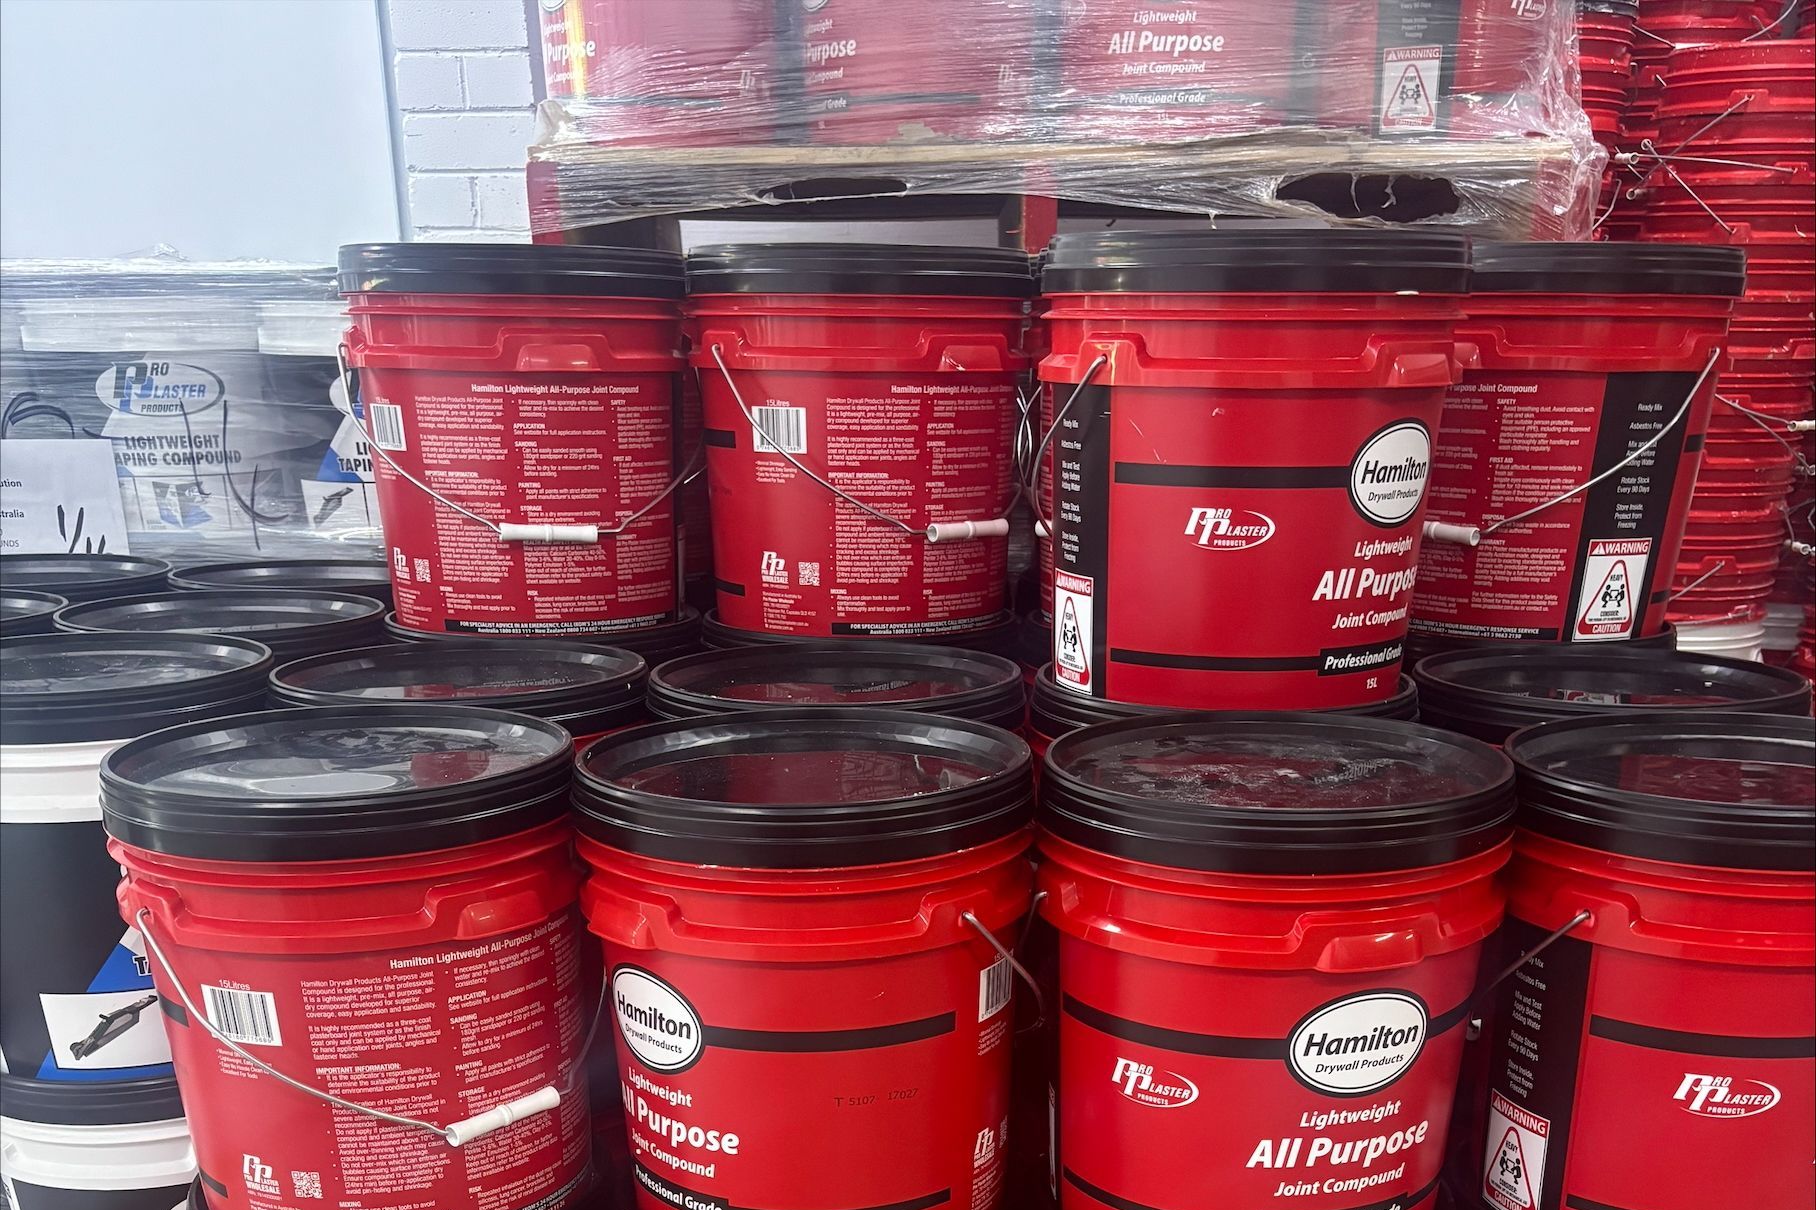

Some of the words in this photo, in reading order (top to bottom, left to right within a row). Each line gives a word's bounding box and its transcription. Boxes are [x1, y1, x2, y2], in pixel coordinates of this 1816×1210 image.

[1133, 10, 1197, 25] Lightweight
[1108, 31, 1135, 54] All
[1138, 31, 1224, 57] Purpose
[1396, 49, 1440, 59] WARNING
[1149, 61, 1205, 75] Compound
[1120, 92, 1177, 104] Professional
[1177, 92, 1206, 102] Grade
[471, 384, 503, 392] Hamilton
[505, 385, 548, 395] Lightweight
[550, 385, 590, 395] All-Purpose
[609, 386, 639, 395] Compound
[891, 385, 922, 393] Hamilton
[923, 386, 960, 395] Lightweight
[1478, 384, 1496, 392] Joint
[1497, 384, 1538, 394] Compound
[125, 435, 219, 450] LIGHTWEIGHT
[114, 452, 157, 466] APING
[163, 451, 242, 466] COMPOUND
[1360, 457, 1427, 485] Hamilton
[1367, 490, 1396, 502] Drywall
[1396, 487, 1418, 500] Products
[1184, 507, 1232, 535] PRO
[1198, 518, 1268, 544] PLASTER
[1354, 537, 1413, 560] Lightweight
[1605, 542, 1648, 554] WARNING
[1312, 568, 1356, 601] All
[1332, 613, 1364, 630] Joint
[1592, 624, 1621, 633] CAUTION
[1325, 648, 1385, 670] Professional
[1367, 677, 1377, 690] 15L
[390, 957, 434, 969] Hamilton
[436, 945, 489, 964] Lightweight
[491, 933, 532, 953] All-Purpose
[533, 926, 548, 940] Joint
[219, 979, 250, 990] 15Litres
[301, 980, 328, 988] Hamilton
[329, 979, 352, 987] Drywall
[354, 977, 381, 985] Products
[302, 988, 335, 996] Compound
[447, 990, 487, 1004] APPLICATION
[617, 990, 692, 1041] Hamilton
[625, 1024, 648, 1044] Drywall
[647, 1034, 683, 1055] Products
[1302, 1022, 1419, 1057] Hamilton
[316, 1067, 353, 1075] IMPORTANT
[1110, 1056, 1154, 1085] PRO
[1314, 1060, 1360, 1075] Drywall
[1360, 1053, 1404, 1069] Products
[628, 1067, 693, 1108] Lightweight
[887, 1087, 920, 1103] 17027
[1123, 1070, 1191, 1098] PLASTER
[1672, 1072, 1733, 1101] PRO
[1137, 1092, 1169, 1106] PRODUCTS
[1688, 1085, 1773, 1111] PLASTER
[621, 1081, 635, 1118] All
[637, 1096, 740, 1156] Purpose
[1299, 1100, 1402, 1131] Lightweight
[1499, 1100, 1546, 1135] WARNING
[1707, 1106, 1745, 1115] PRODUCTS
[632, 1128, 650, 1155] Joint
[650, 1142, 715, 1179] Compound
[1245, 1137, 1303, 1169] All
[1306, 1120, 1429, 1168] Purpose
[635, 1164, 684, 1206] Professional
[1273, 1180, 1322, 1198] Joint
[1323, 1163, 1405, 1196] Compound
